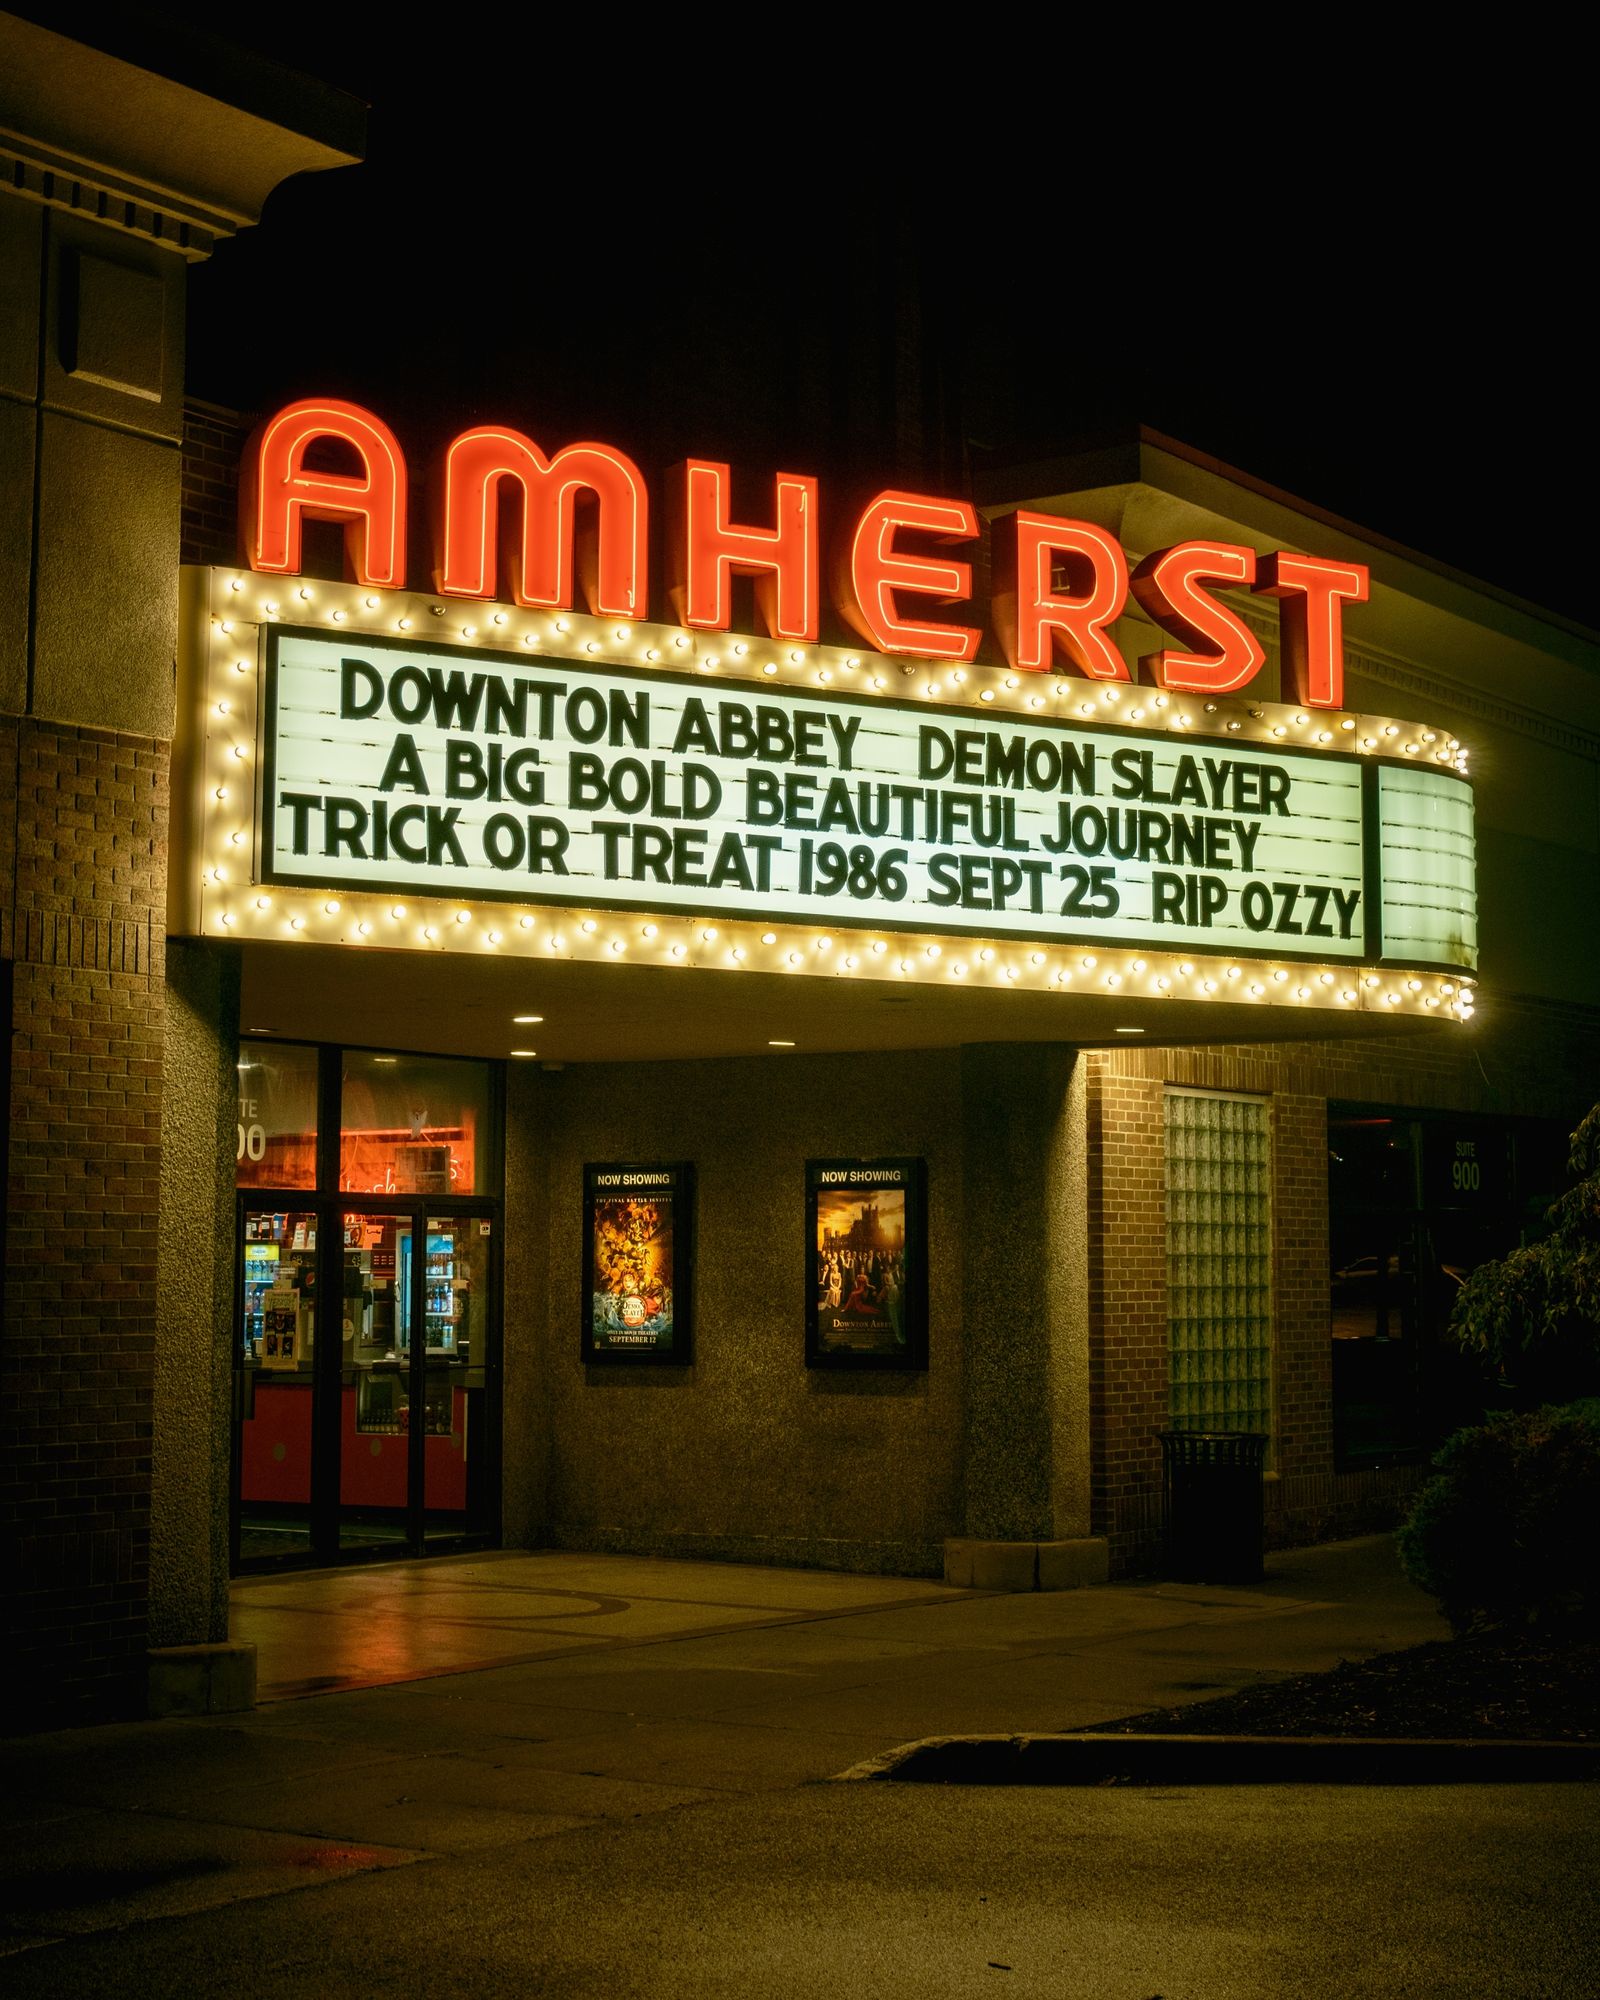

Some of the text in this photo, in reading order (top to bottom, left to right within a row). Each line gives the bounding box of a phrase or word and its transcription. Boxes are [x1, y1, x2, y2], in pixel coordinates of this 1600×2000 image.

[250, 398, 1370, 710] AMHERST
[341, 657, 1292, 818] DOWNTON ABBEY DEMON SLAYER
[378, 733, 1262, 873] A BIG BOLD BEAUTIFUL JOURNEY
[280, 791, 1362, 941] TRICK OR TREAT 1986 SEPT 25 RIP OZZY
[1455, 1140, 1477, 1158] SUITE
[597, 1173, 670, 1186] NOW SHOWING
[821, 1170, 901, 1183] NOW SHOWING
[1452, 1160, 1480, 1191] 900
[608, 1336, 657, 1344] SEPTEMBER 12
